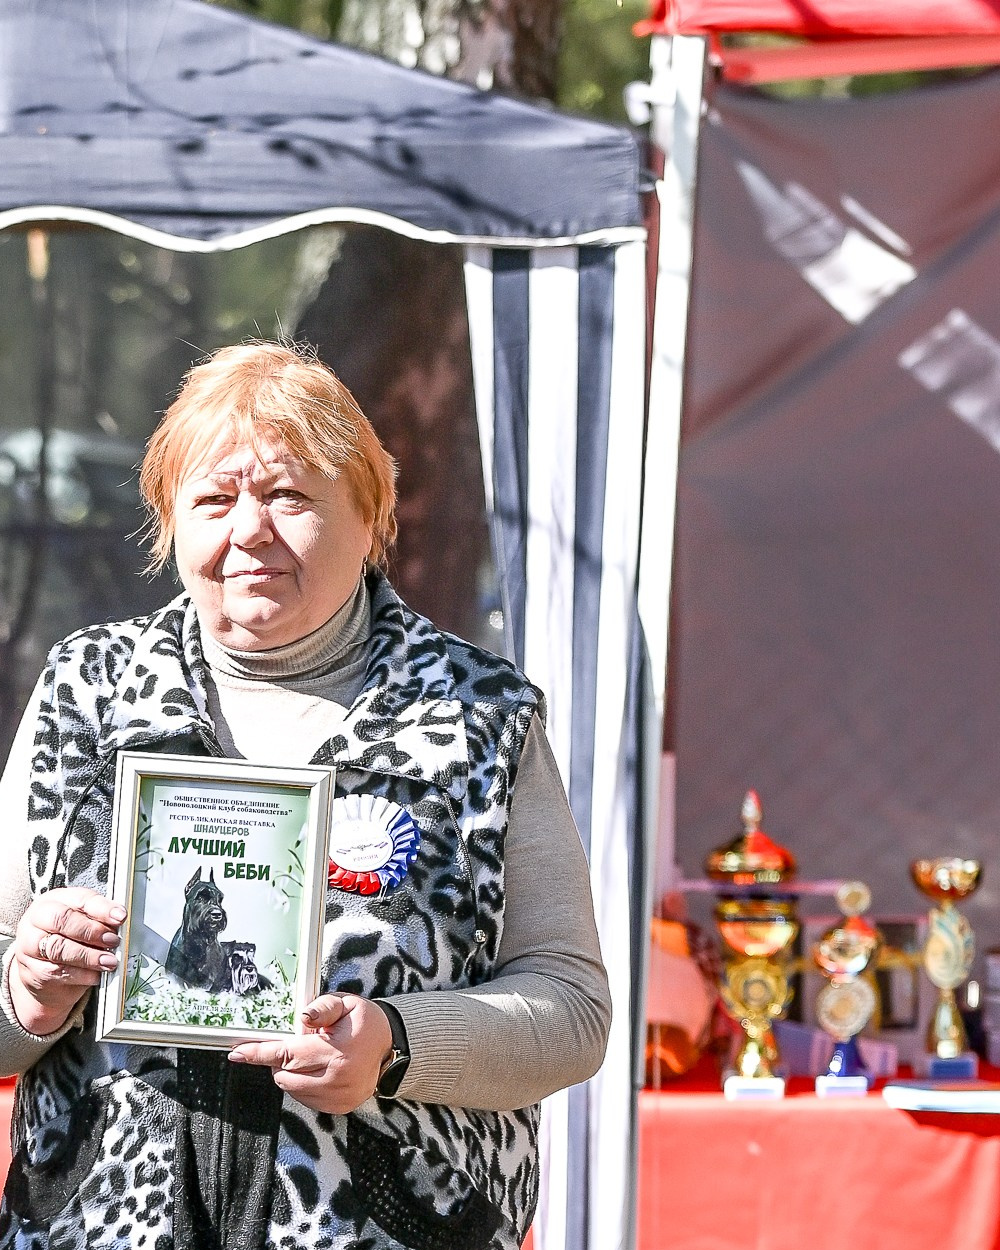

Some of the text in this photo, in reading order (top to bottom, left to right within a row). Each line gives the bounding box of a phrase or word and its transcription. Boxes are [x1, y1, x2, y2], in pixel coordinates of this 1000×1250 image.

[173, 795, 230, 805] ОБЩЕСТВЕННОЕ
[218, 804, 236, 813] клуб
[193, 823, 250, 837] ШНАУЦЕРОВ
[238, 820, 276, 828] ВЫСТАВКА
[167, 836, 246, 859] ЛУЧШИЙ
[223, 862, 271, 881] БЕБИ
